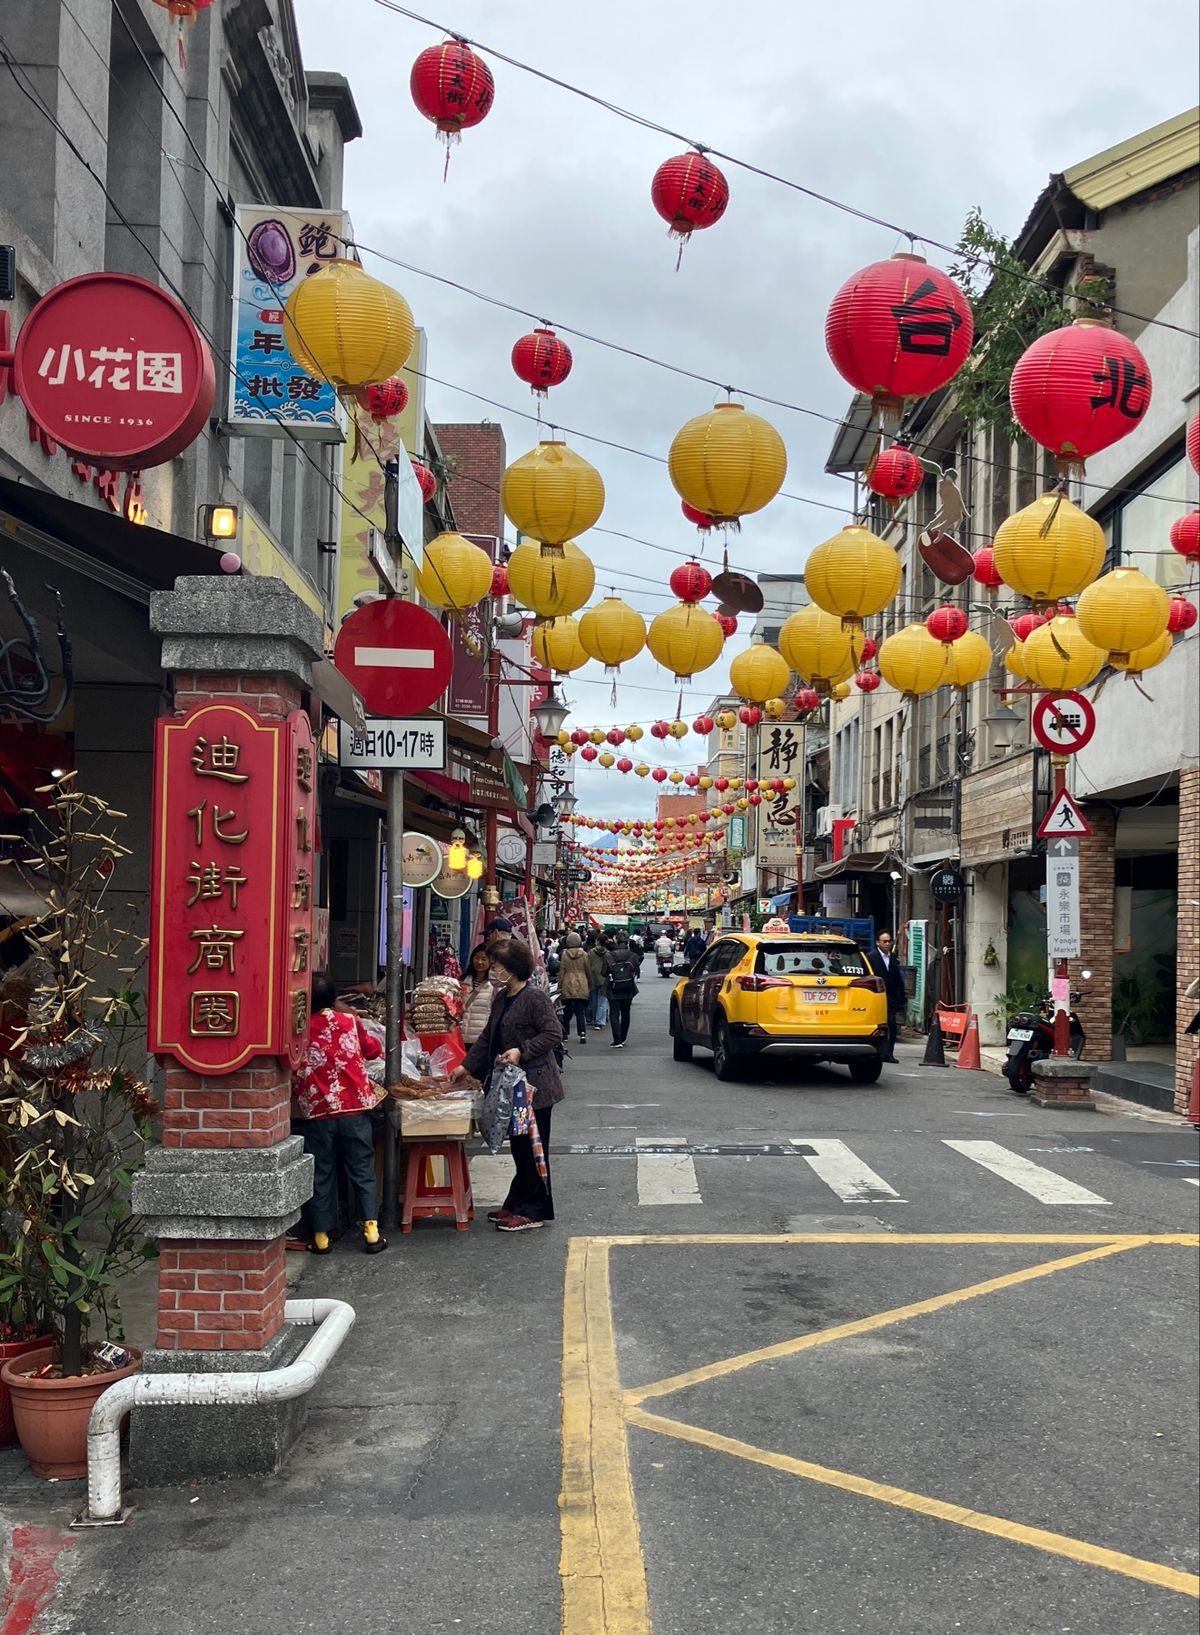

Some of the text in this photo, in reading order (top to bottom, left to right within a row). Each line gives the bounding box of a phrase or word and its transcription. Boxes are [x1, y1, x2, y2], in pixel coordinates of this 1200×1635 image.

[892, 278, 963, 356] 台
[38, 344, 183, 394] 小花園
[248, 375, 323, 401] 批發
[1090, 356, 1147, 418] 北
[64, 414, 154, 426] SINCE 1936
[187, 735, 249, 1037] 迪化街商圈
[1059, 888, 1071, 936] 永樂市場
[1053, 937, 1077, 945] Yongle
